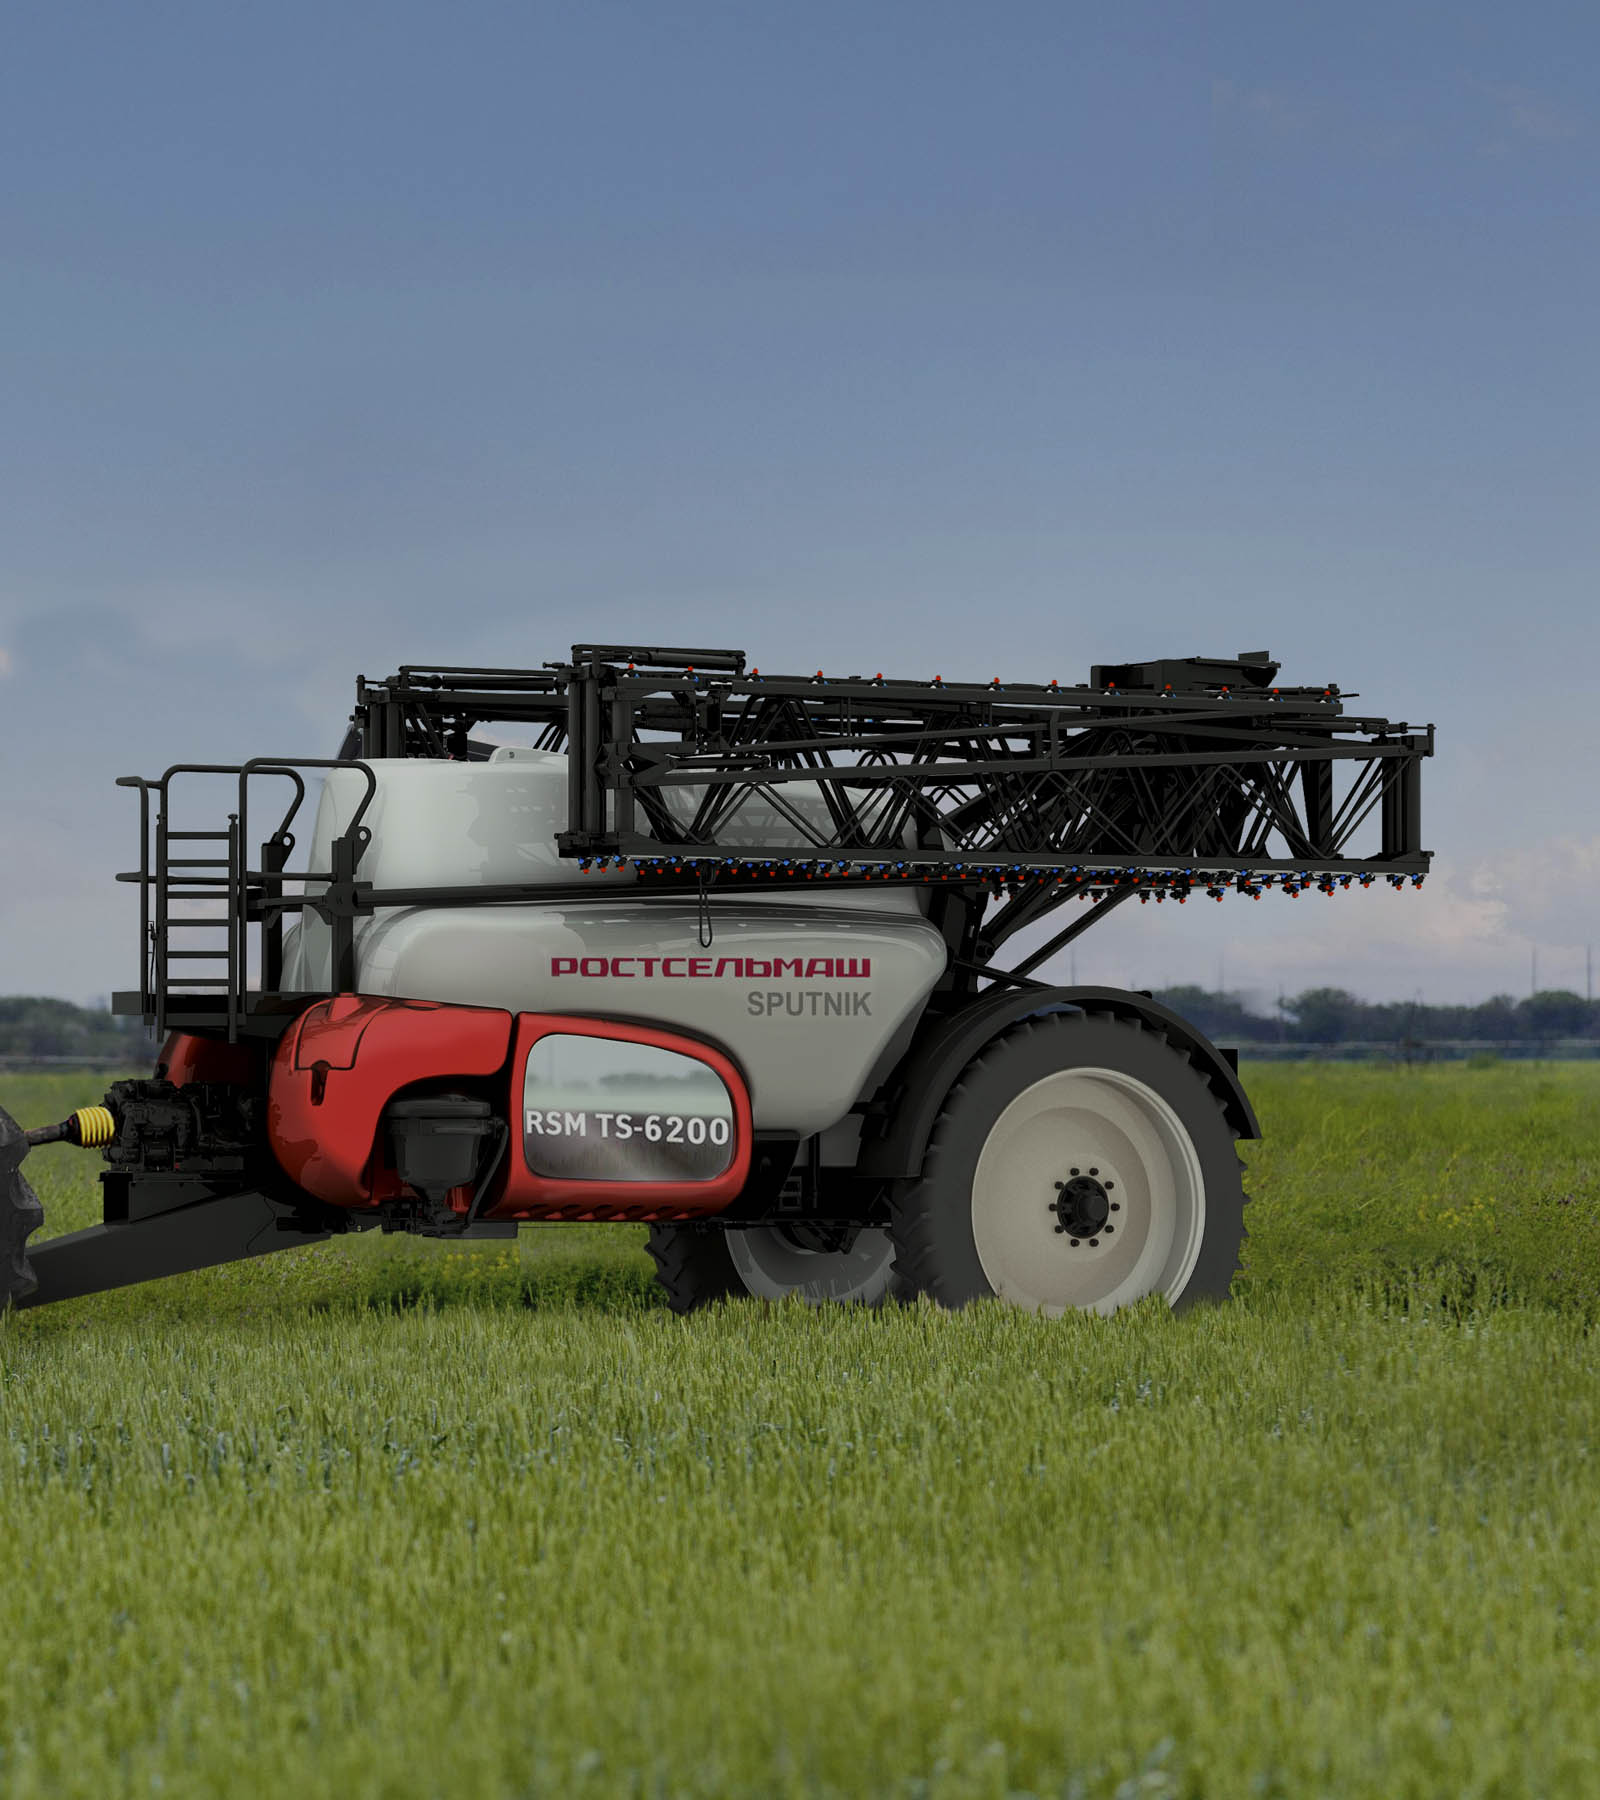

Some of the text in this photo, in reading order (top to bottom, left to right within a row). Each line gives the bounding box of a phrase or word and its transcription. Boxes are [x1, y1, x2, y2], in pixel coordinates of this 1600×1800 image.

[550, 957, 871, 978] РОСТСЕЛЬМАШ
[747, 991, 872, 1017] SPUTNIK
[526, 1110, 730, 1145] RSM TS-6200
